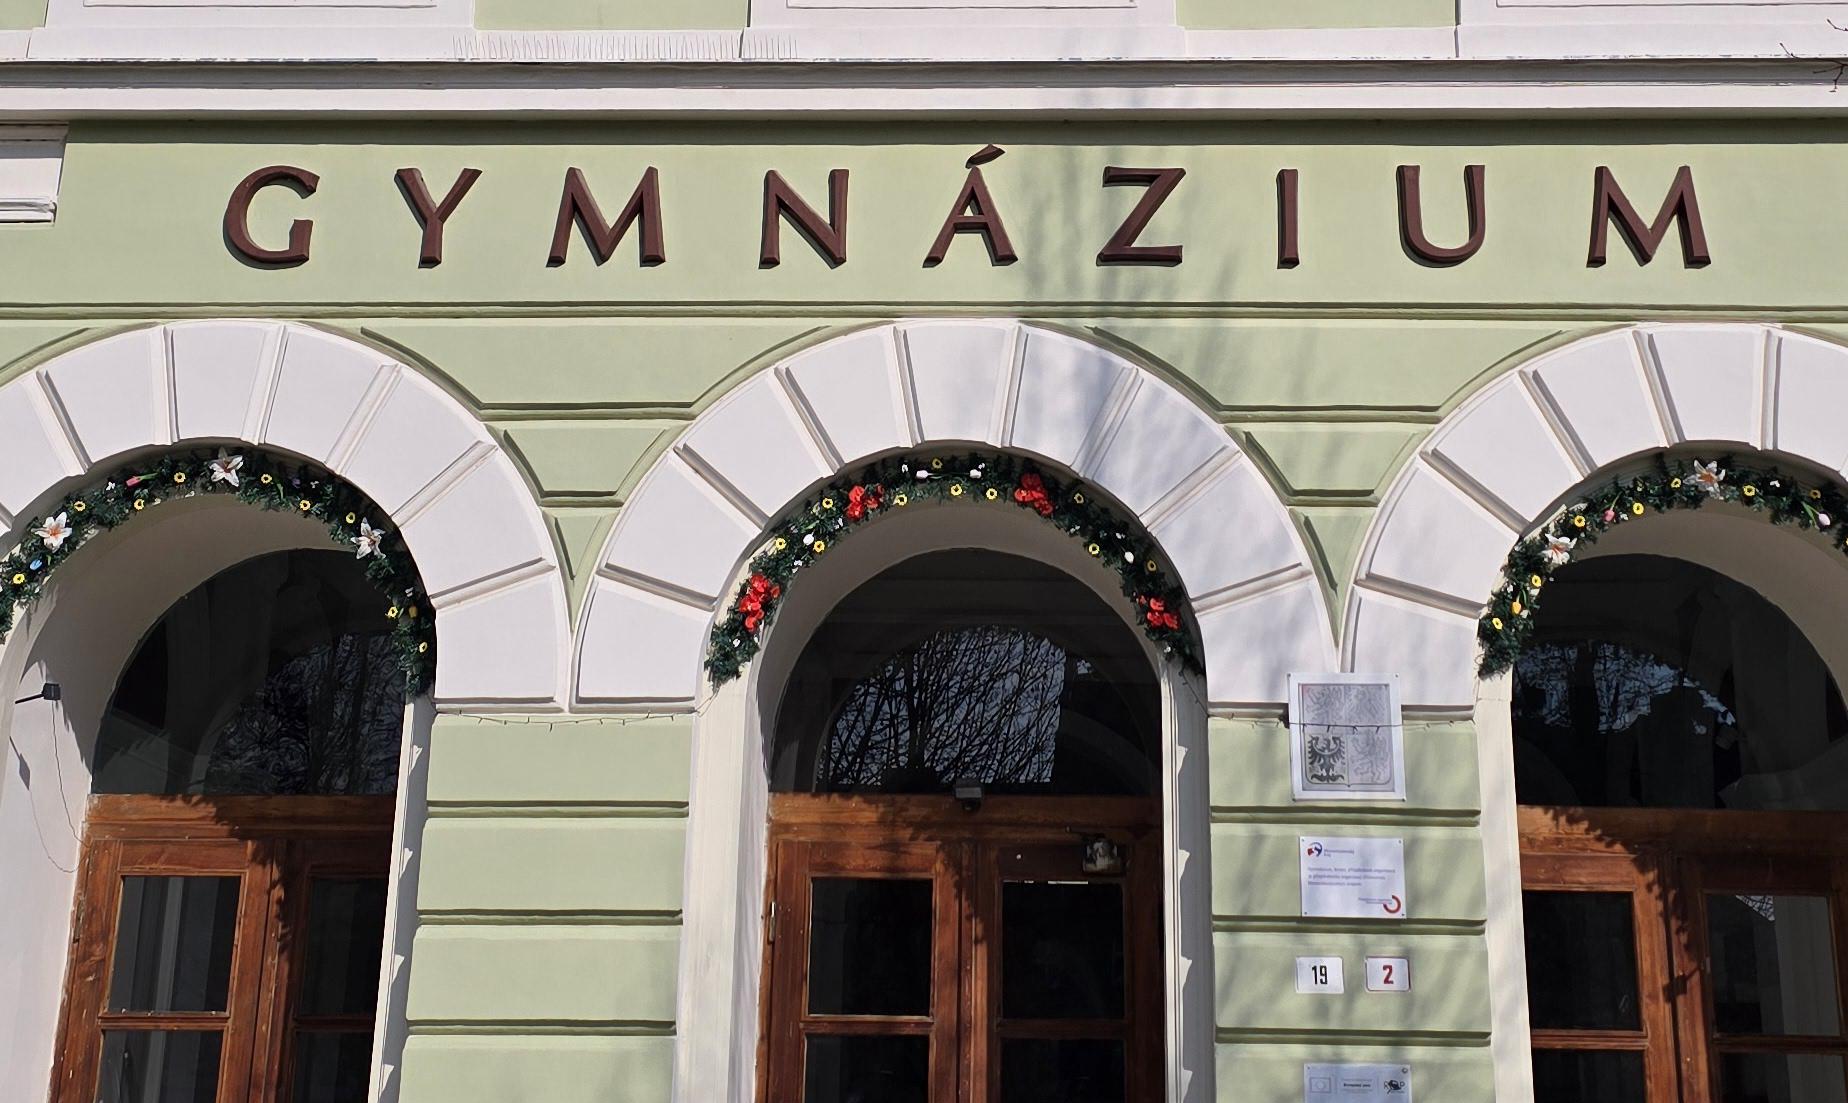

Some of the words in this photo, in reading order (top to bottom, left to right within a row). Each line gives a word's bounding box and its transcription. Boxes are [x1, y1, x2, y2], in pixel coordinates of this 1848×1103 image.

[224, 144, 1711, 268] GYMNÁZIUM
[1312, 965, 1328, 985] 19
[1382, 965, 1394, 985] 2
